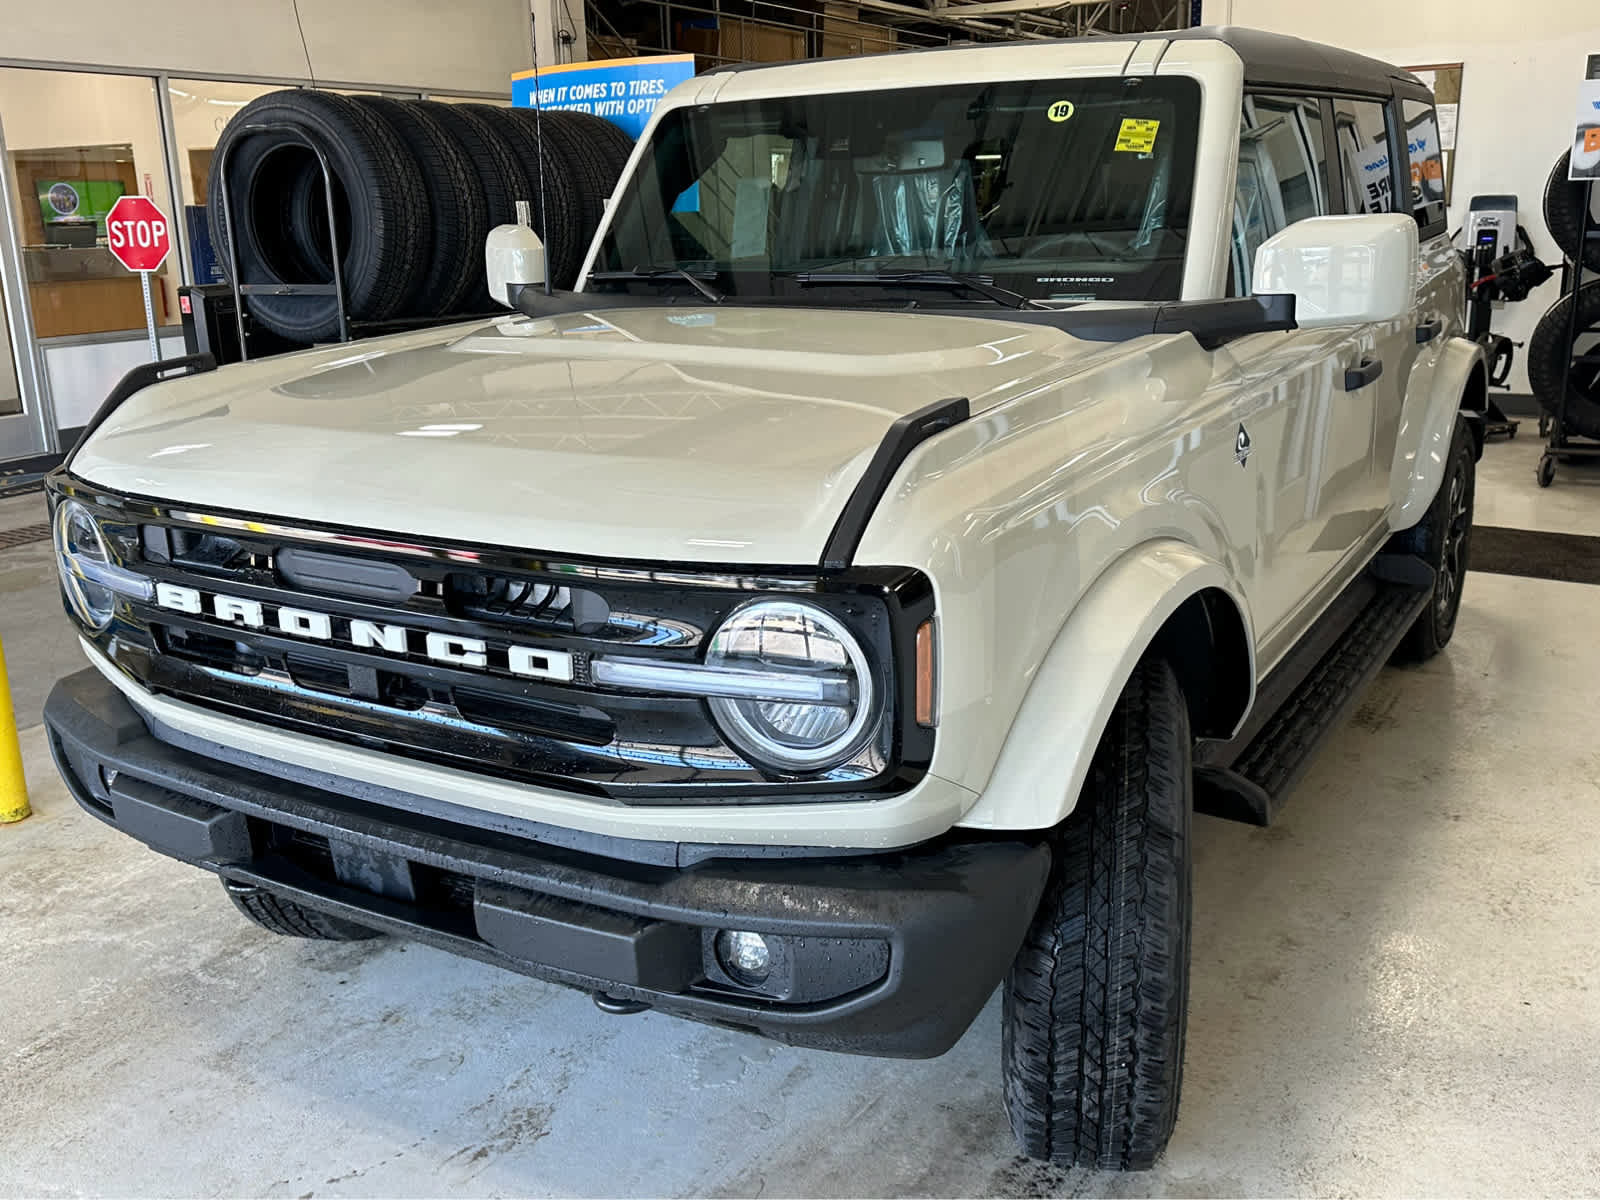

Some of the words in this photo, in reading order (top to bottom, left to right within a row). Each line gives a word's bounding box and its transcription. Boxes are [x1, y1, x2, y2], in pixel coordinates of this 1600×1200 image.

[529, 87, 556, 106] WHEN
[557, 86, 568, 102] IT
[569, 82, 607, 100] COMES
[609, 82, 626, 97] TO
[628, 79, 668, 96] TIRES,
[594, 100, 625, 116] WITH
[627, 98, 662, 115] OPTI
[1053, 105, 1069, 117] 19
[110, 220, 167, 249] STOP
[156, 582, 574, 682] BRONCO
